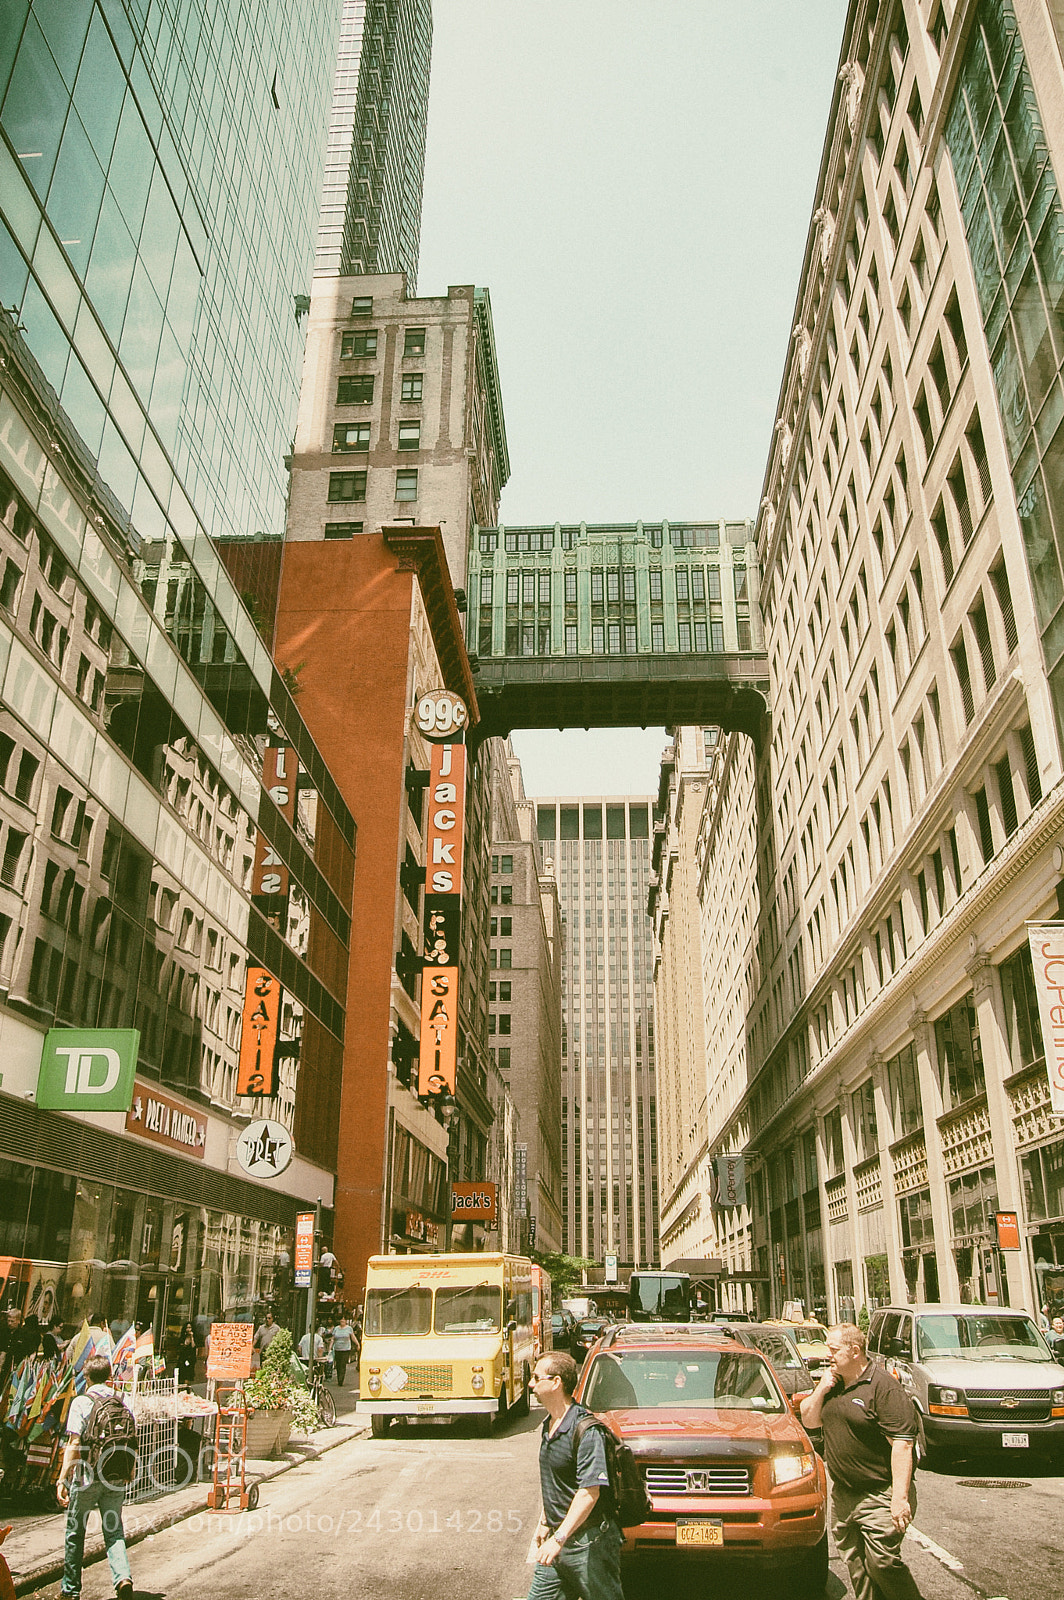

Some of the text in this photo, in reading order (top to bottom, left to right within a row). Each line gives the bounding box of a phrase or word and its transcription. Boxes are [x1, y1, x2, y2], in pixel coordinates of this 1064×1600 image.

[418, 698, 465, 731] 99¢
[432, 744, 456, 893] jacks
[56, 1047, 121, 1094] TD
[145, 1098, 198, 1148] PRET A MANGER
[245, 1136, 284, 1163] PRET
[727, 1160, 737, 1204] JCPenney
[452, 1191, 491, 1213] jack's
[213, 1328, 247, 1338] FLAGS
